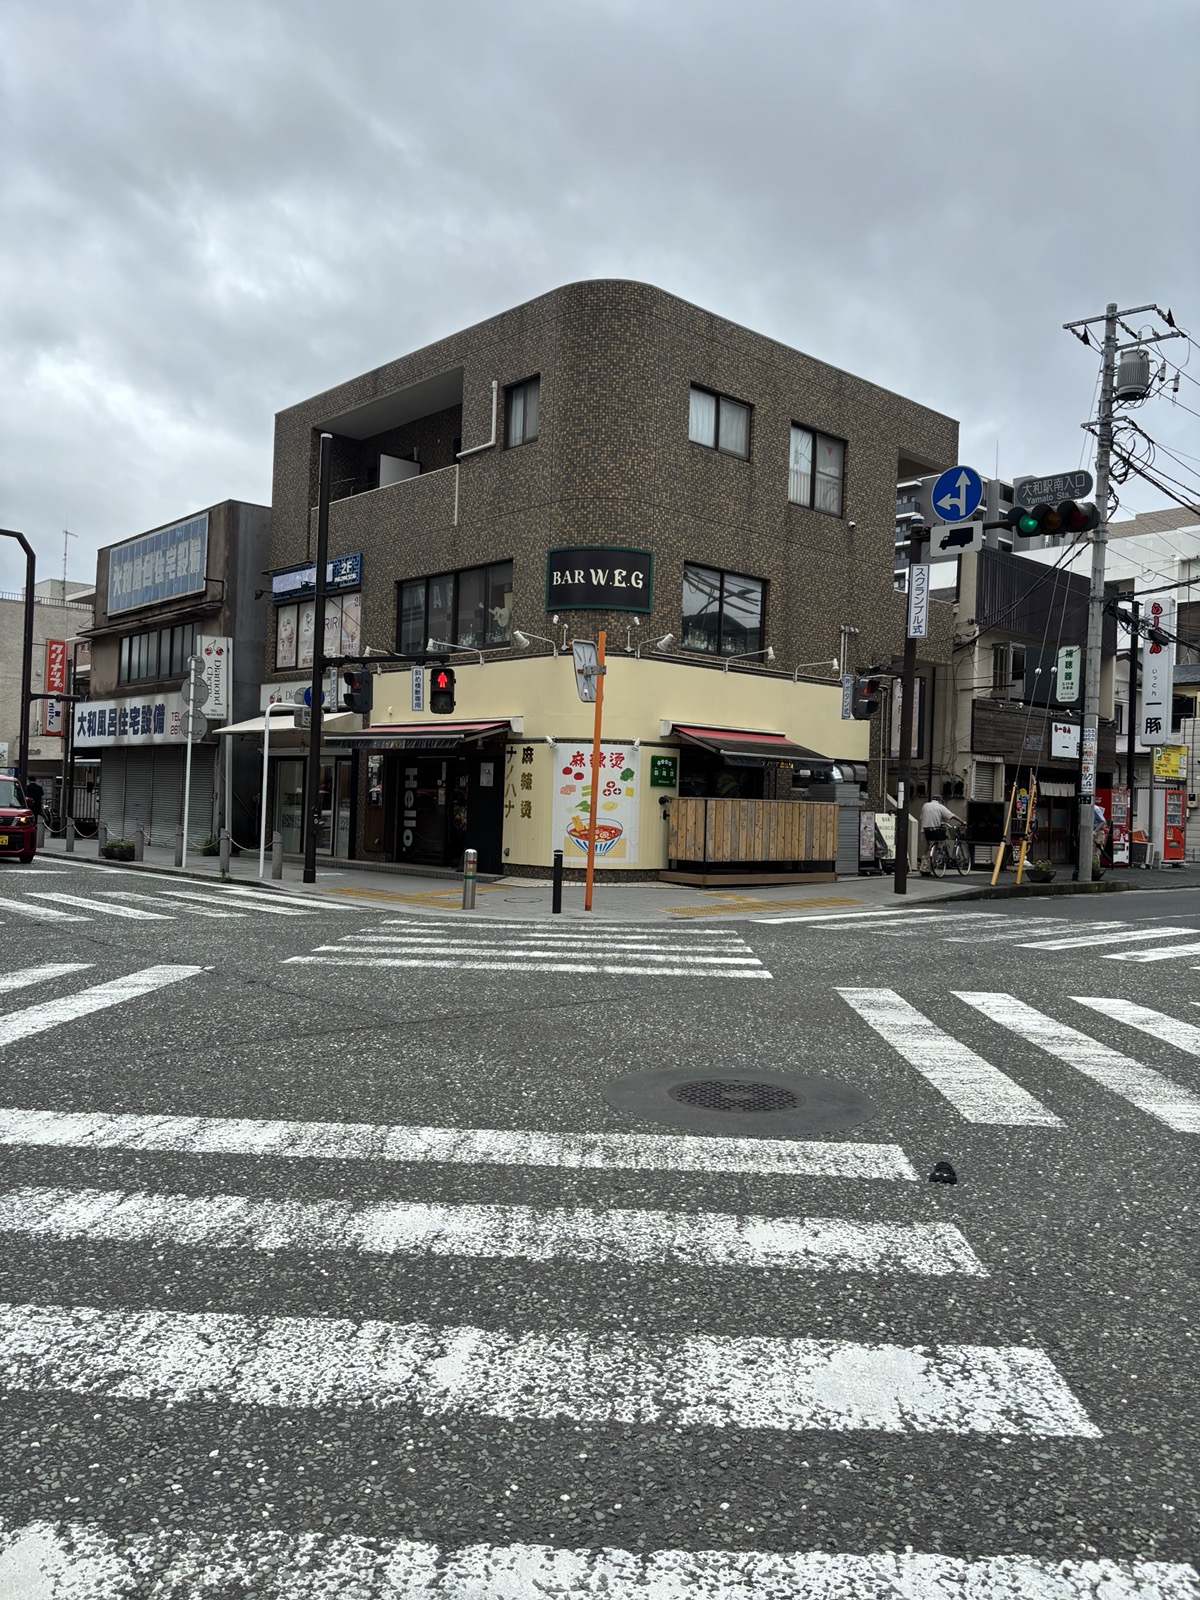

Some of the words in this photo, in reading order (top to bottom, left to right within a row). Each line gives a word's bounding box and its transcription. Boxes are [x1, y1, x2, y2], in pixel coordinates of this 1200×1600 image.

[1022, 473, 1085, 498] 大和駅南入口
[1027, 494, 1054, 505] Yamato
[1056, 491, 1072, 500] Sta.
[1074, 488, 1083, 497] S.
[340, 561, 352, 575] 2F
[552, 569, 586, 586] BAR
[589, 568, 644, 589] W.E.G
[912, 567, 926, 634] スクランブル式
[1149, 603, 1163, 654] らーん
[1064, 649, 1074, 681] 補聴器
[214, 659, 223, 706] Diamond
[77, 704, 165, 737] 大和風呂住宅設備
[1145, 702, 1162, 735] 一豚
[504, 745, 517, 819] ナノハナ
[403, 767, 418, 852] Hello.
